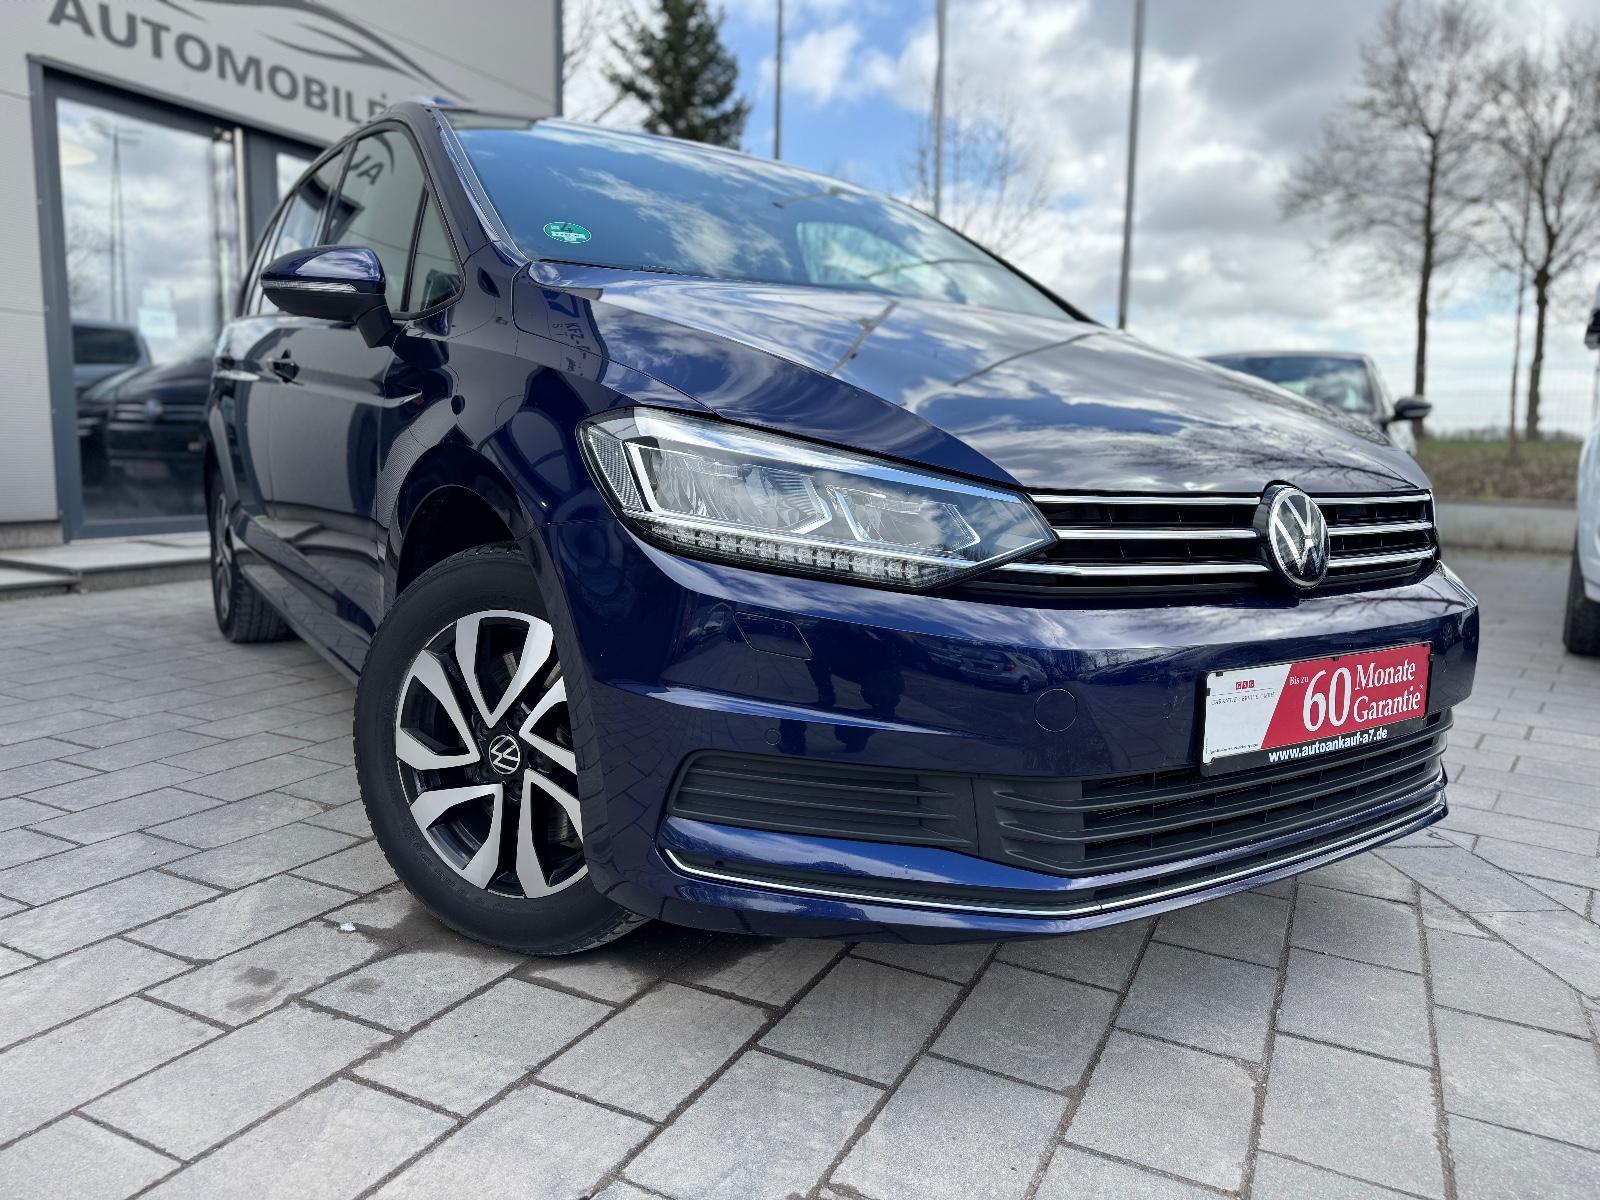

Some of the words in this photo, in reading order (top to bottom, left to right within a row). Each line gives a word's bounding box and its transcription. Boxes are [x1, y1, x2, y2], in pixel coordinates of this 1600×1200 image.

[1290, 675, 1300, 685] Bis
[1300, 676, 1309, 684] zu
[1355, 659, 1416, 690] Monate
[1303, 668, 1351, 732] 60
[1353, 685, 1421, 722] Garantie
[1269, 727, 1388, 763] www.autoankauf-a7.de
